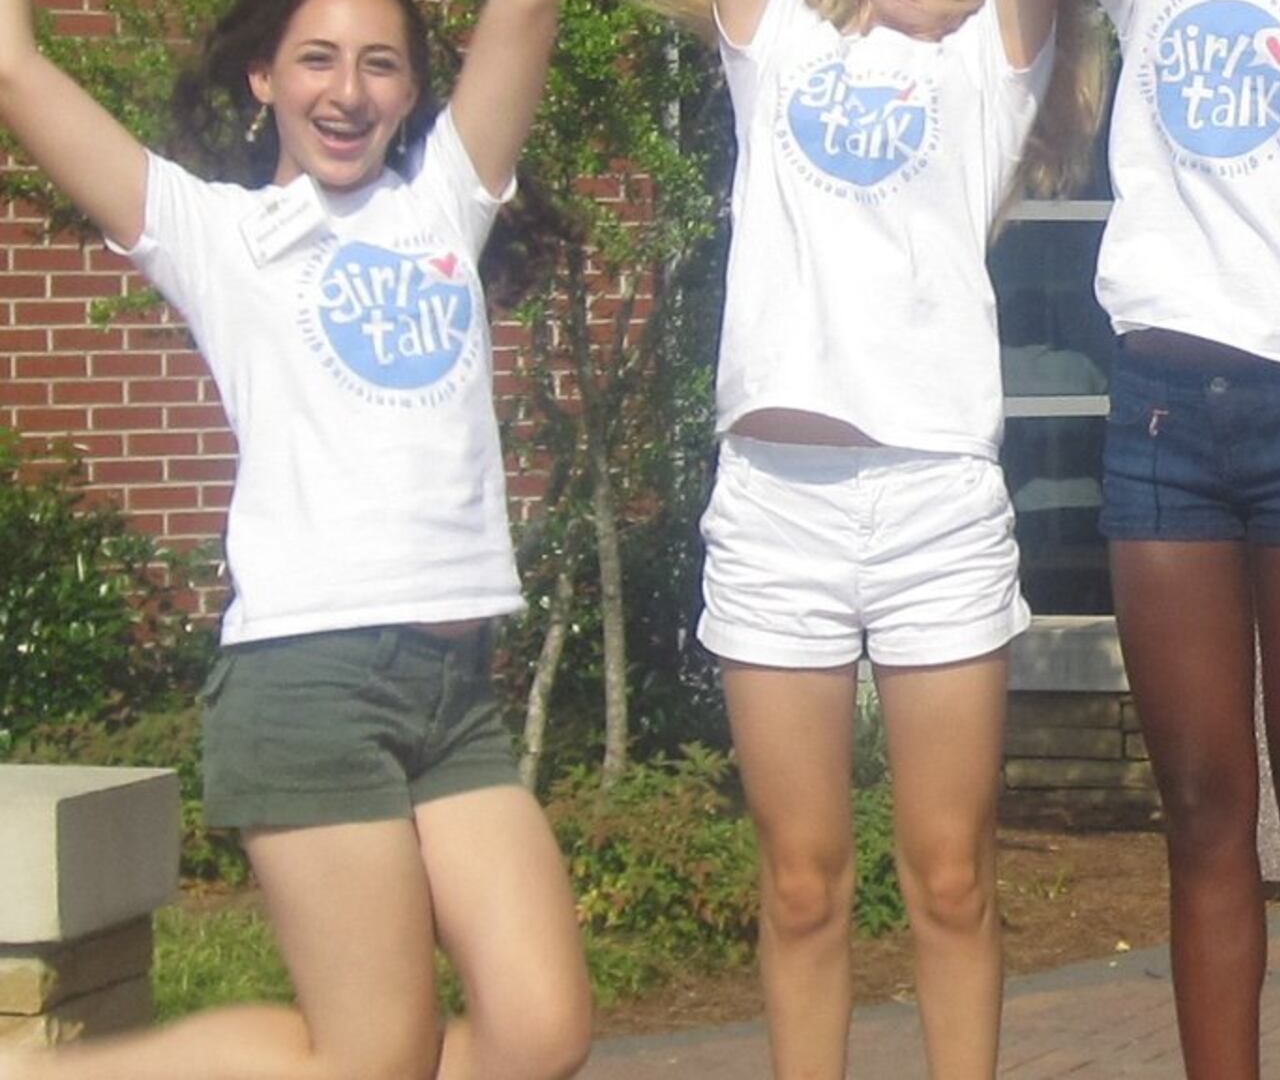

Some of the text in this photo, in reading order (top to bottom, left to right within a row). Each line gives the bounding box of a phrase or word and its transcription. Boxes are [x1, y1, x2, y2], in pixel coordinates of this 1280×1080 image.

[1156, 25, 1250, 83] girl
[819, 103, 917, 161] talk
[315, 258, 417, 324] girl
[361, 294, 468, 366] talk
